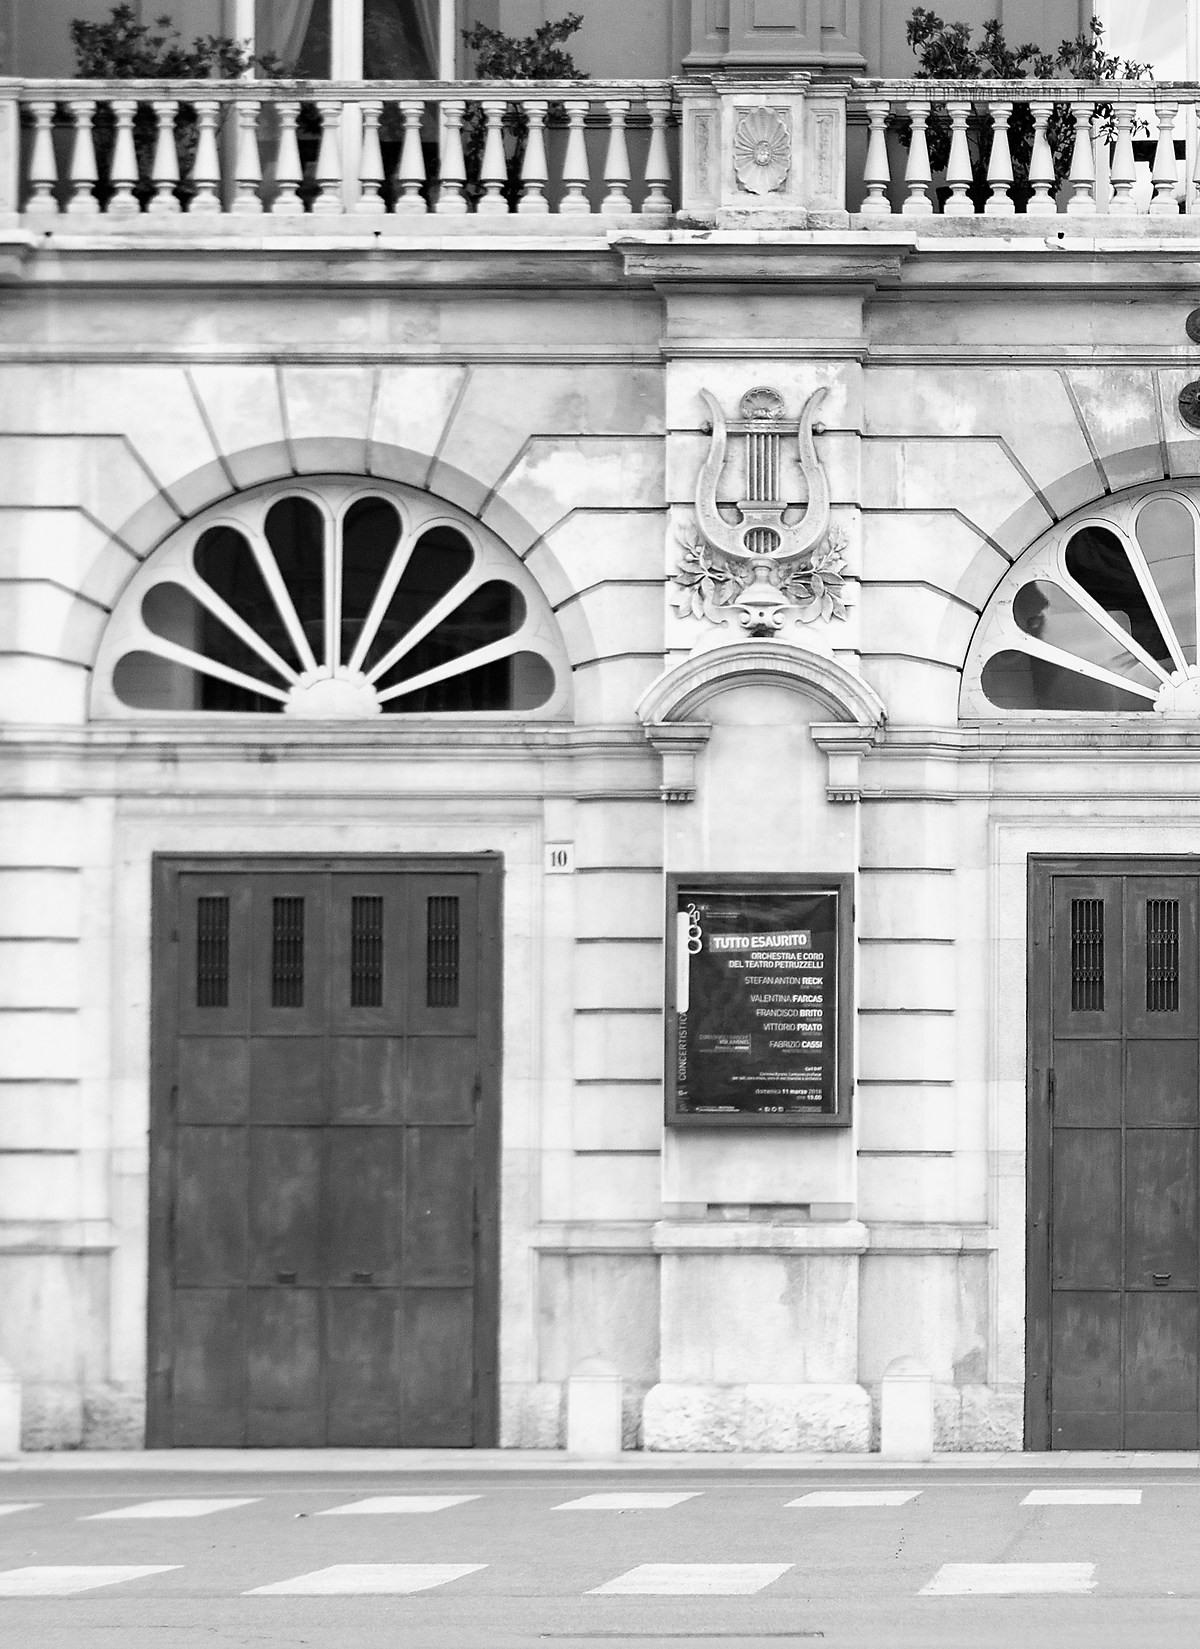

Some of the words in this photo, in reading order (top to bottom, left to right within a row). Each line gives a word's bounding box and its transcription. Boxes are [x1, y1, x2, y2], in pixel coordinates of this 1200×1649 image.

[551, 850, 567, 867] 10
[713, 936, 750, 949] TUTTO
[751, 934, 807, 948] ESAURITO
[751, 952, 796, 960] ORCHESTRA
[728, 960, 744, 968] DEL
[744, 976, 774, 985] STEFAN
[774, 977, 800, 985] ANTON
[801, 977, 823, 985] RECK
[750, 994, 792, 1002] VALENTINA
[792, 995, 823, 1003] FARCAS
[756, 1008, 799, 1016] FRANCISCO
[799, 1009, 823, 1017] BRITO
[763, 1022, 796, 1031] VITTORIO
[796, 1023, 823, 1031] PRATO
[678, 1011, 688, 1081] CONCERTISTICA
[769, 1040, 801, 1048] FABRIZIO
